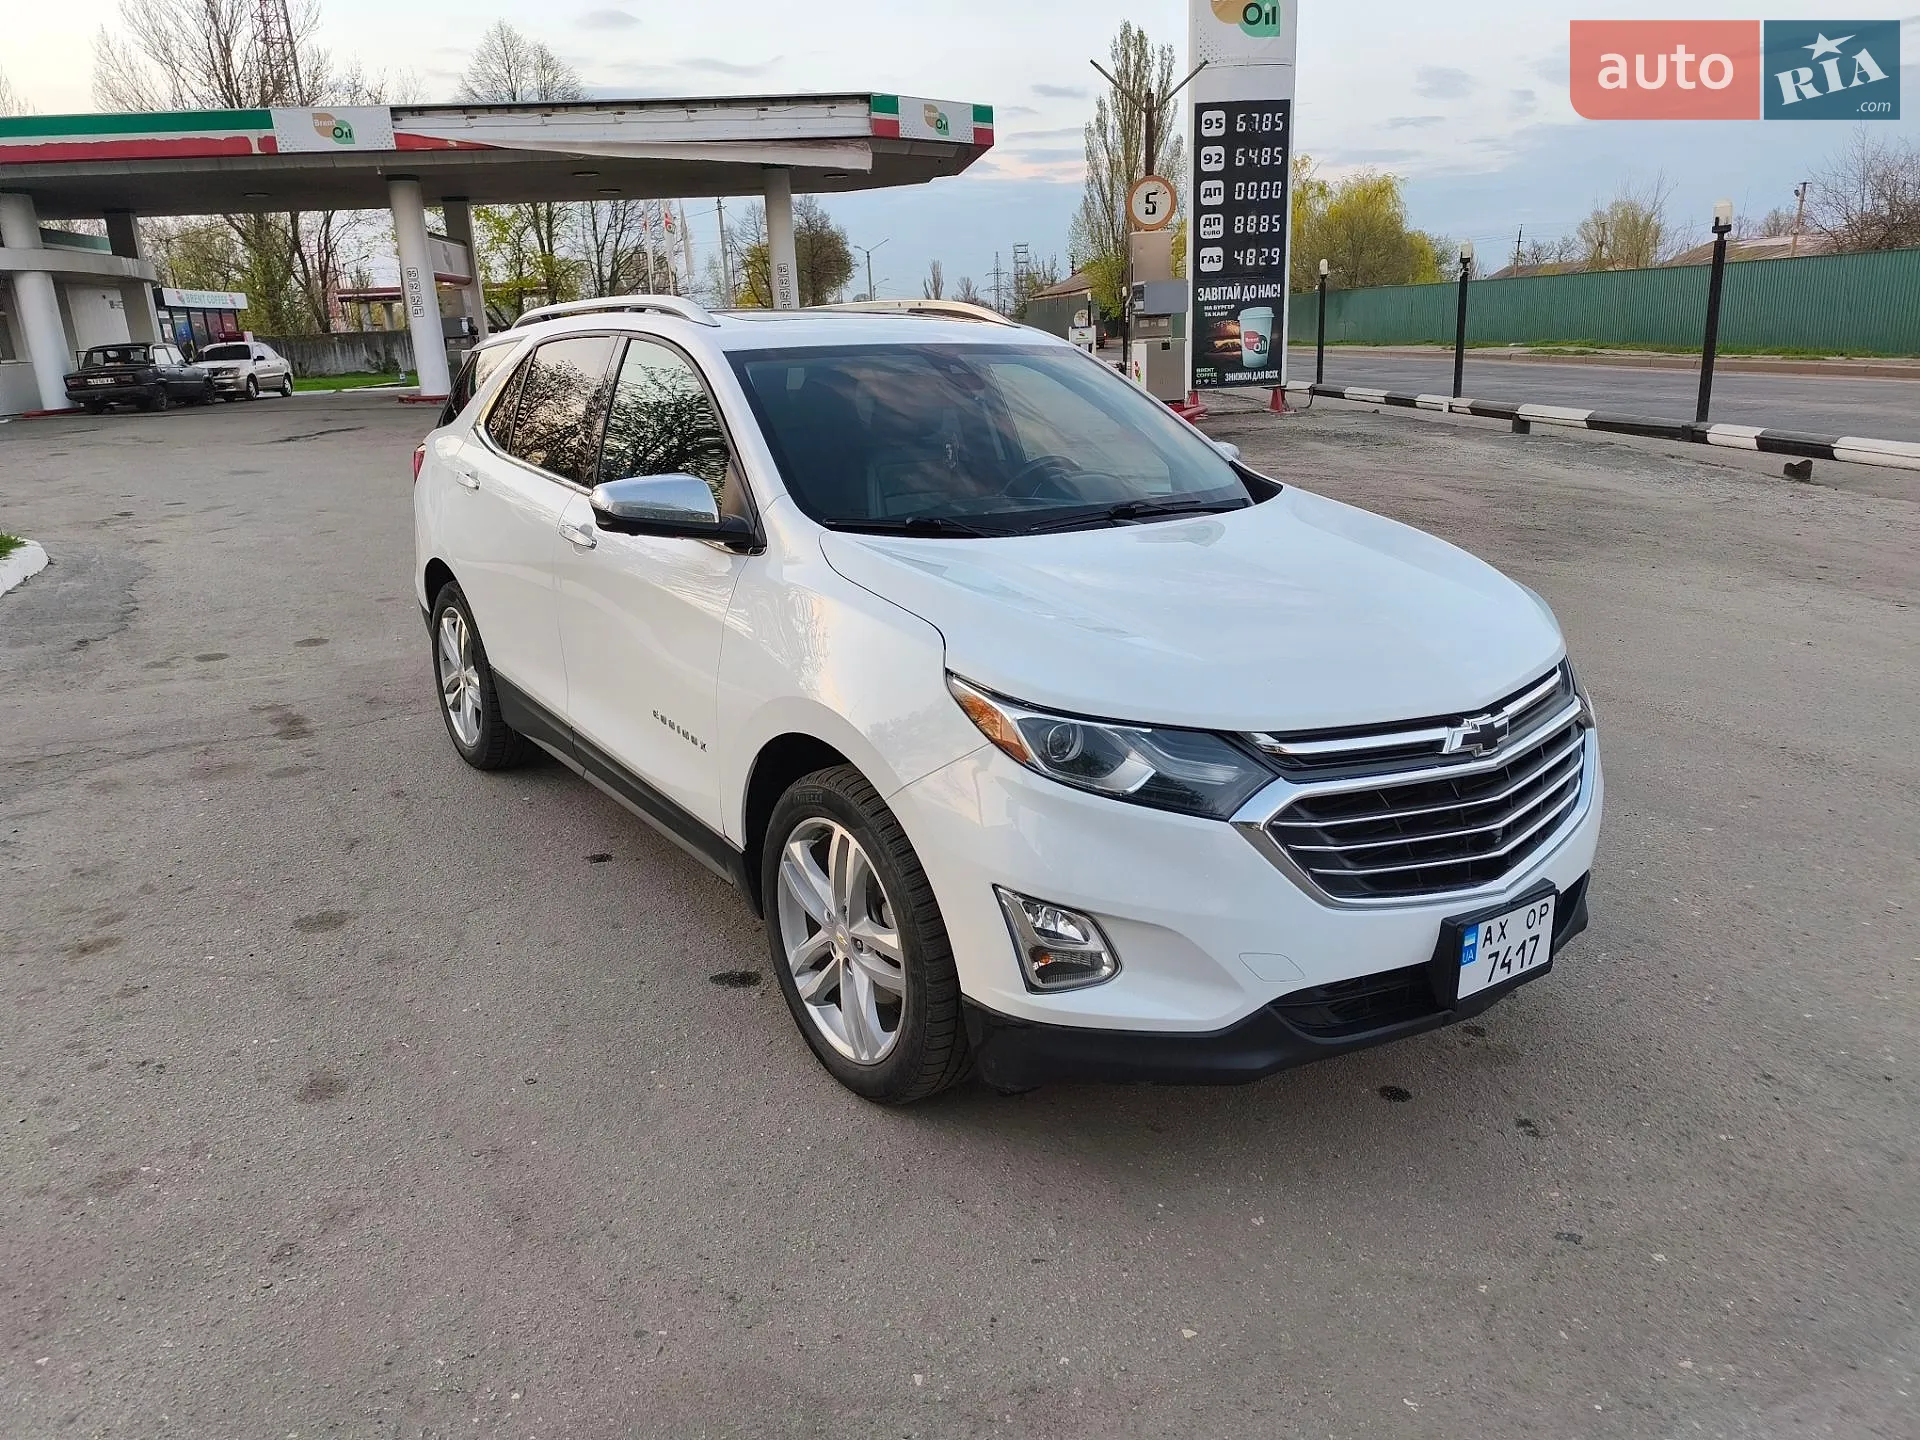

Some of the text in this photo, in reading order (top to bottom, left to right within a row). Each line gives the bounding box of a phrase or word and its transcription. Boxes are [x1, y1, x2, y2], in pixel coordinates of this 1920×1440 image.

[1243, 3, 1277, 25] Oil
[313, 119, 336, 127] Brent
[936, 118, 948, 130] Oil
[1203, 118, 1224, 130] 95
[333, 126, 352, 138] Oil
[1203, 147, 1283, 167] 92 64.85
[1203, 181, 1282, 201] ДП 00.00
[1144, 191, 1159, 216] 5
[1203, 217, 1221, 229] ДП
[1201, 255, 1222, 265] ГАЗ
[1198, 283, 1281, 301] ЗАВІТАЙ ДО НАС!
[185, 293, 229, 305] BRENT COFFEE
[1254, 340, 1267, 351] Oil
[1225, 373, 1252, 382] ЗНИЖКИ
[1252, 371, 1264, 381] ДЛЯ
[1482, 903, 1549, 948] AX OP
[1462, 952, 1474, 963] UA
[1487, 934, 1540, 983] 7417
